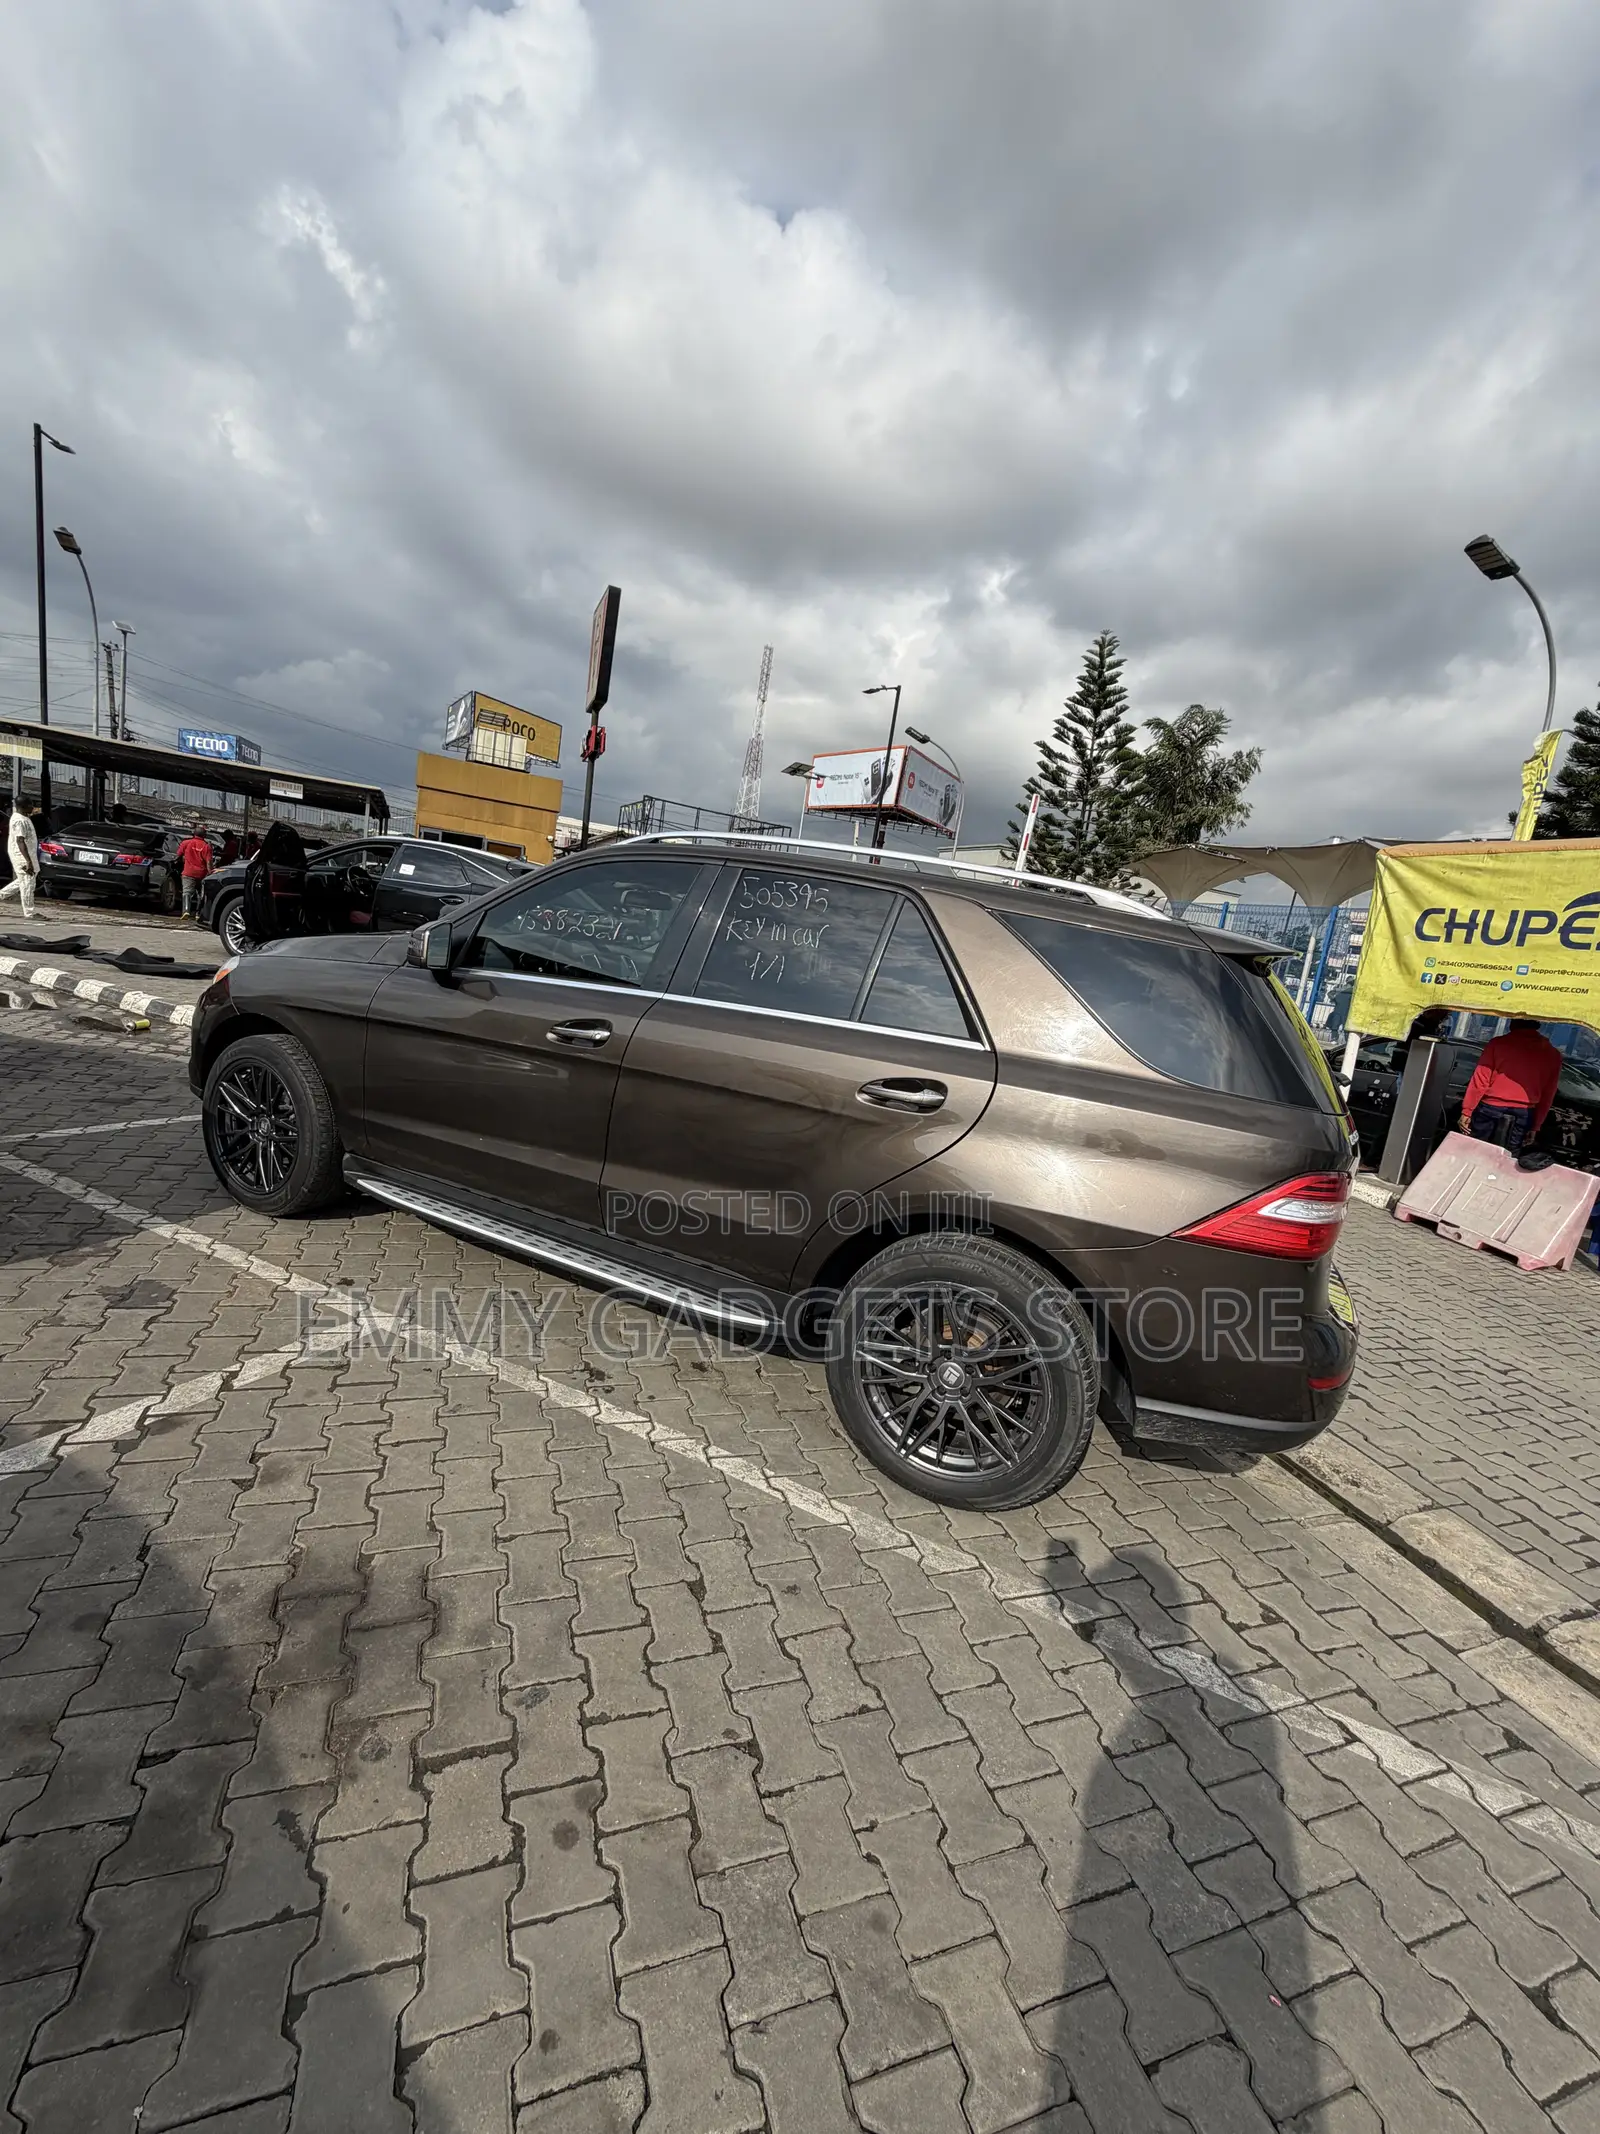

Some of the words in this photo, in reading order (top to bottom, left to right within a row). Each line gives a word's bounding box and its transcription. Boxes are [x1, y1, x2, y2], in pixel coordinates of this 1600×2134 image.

[503, 717, 536, 741] POCO
[187, 735, 228, 752] TECNO
[241, 744, 259, 761] TECNO
[1414, 907, 1600, 951] CHUPE
[1514, 983, 1589, 994] WWW.CHUPEZ.COM
